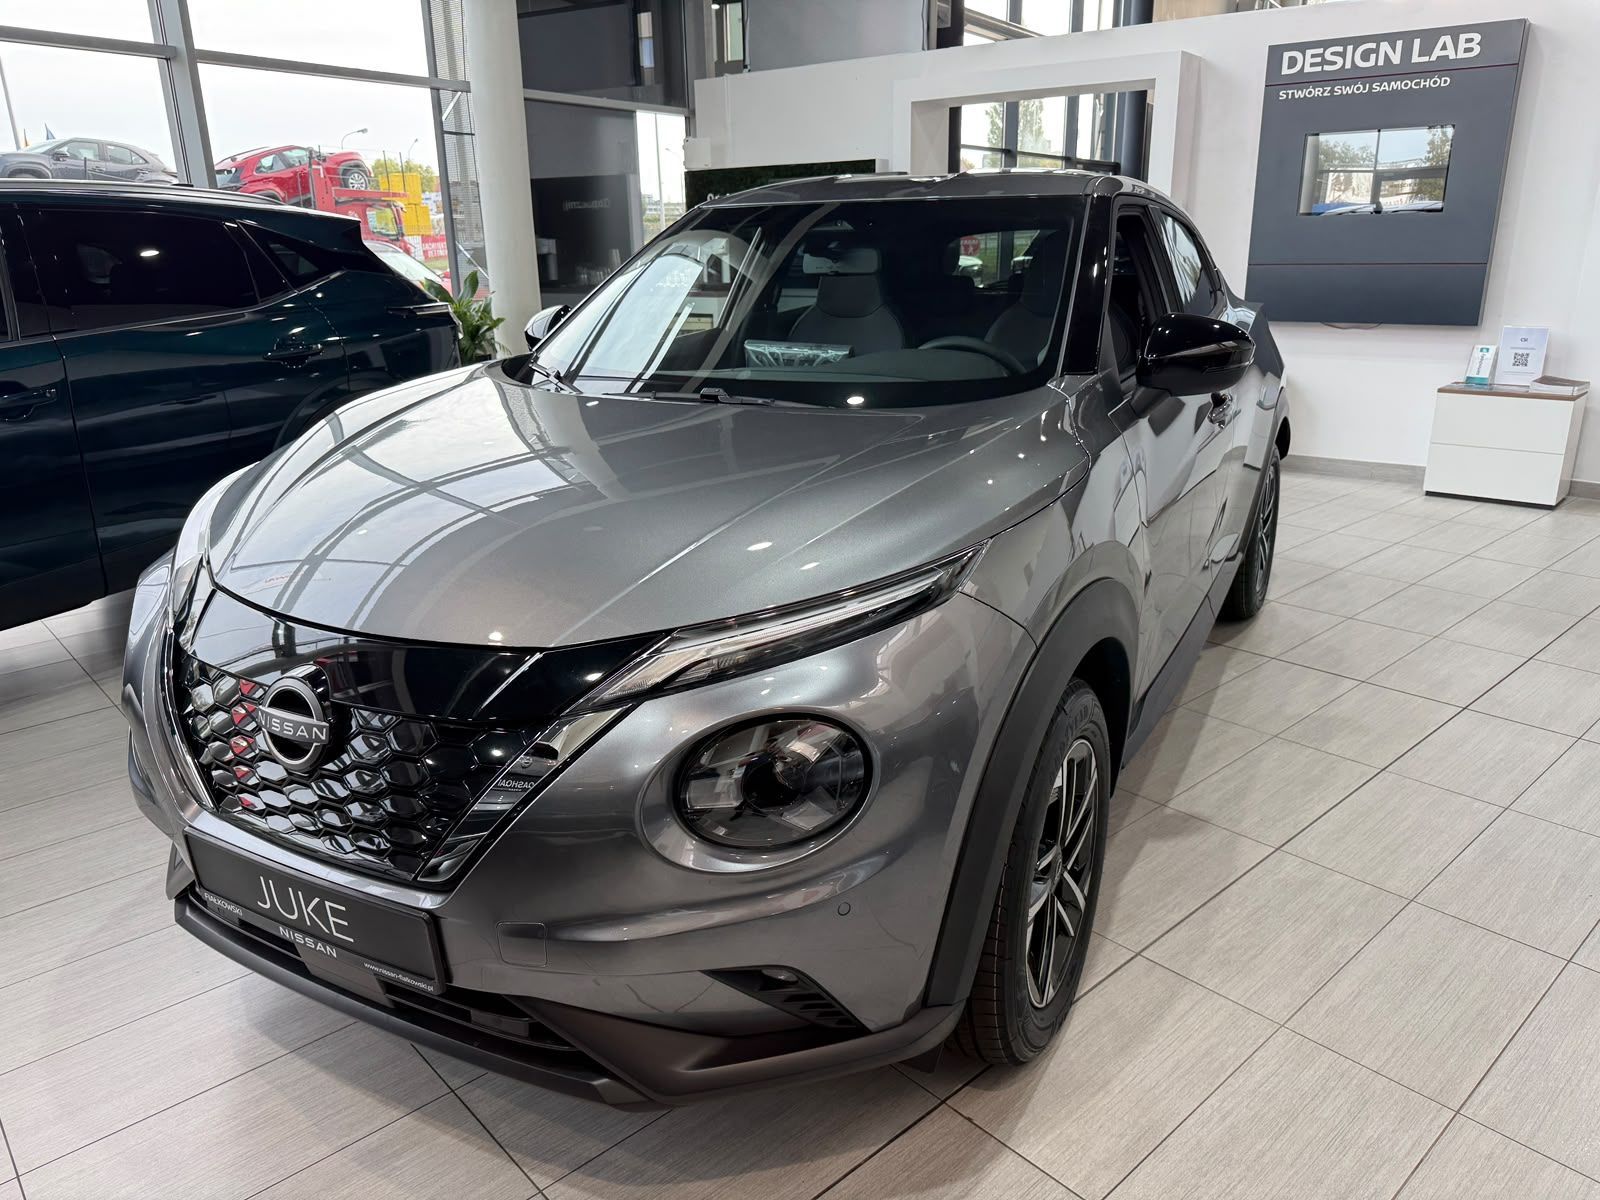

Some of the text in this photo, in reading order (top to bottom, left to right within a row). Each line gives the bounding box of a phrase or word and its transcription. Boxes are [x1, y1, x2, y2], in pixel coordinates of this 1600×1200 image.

[1281, 32, 1481, 76] DESIGN LAB
[1279, 74, 1451, 100] STWÓRZ SWÓJ SAMOCHÓD
[258, 710, 327, 741] NISSAN
[257, 876, 354, 943] JUKE
[279, 926, 337, 958] NISSAN
